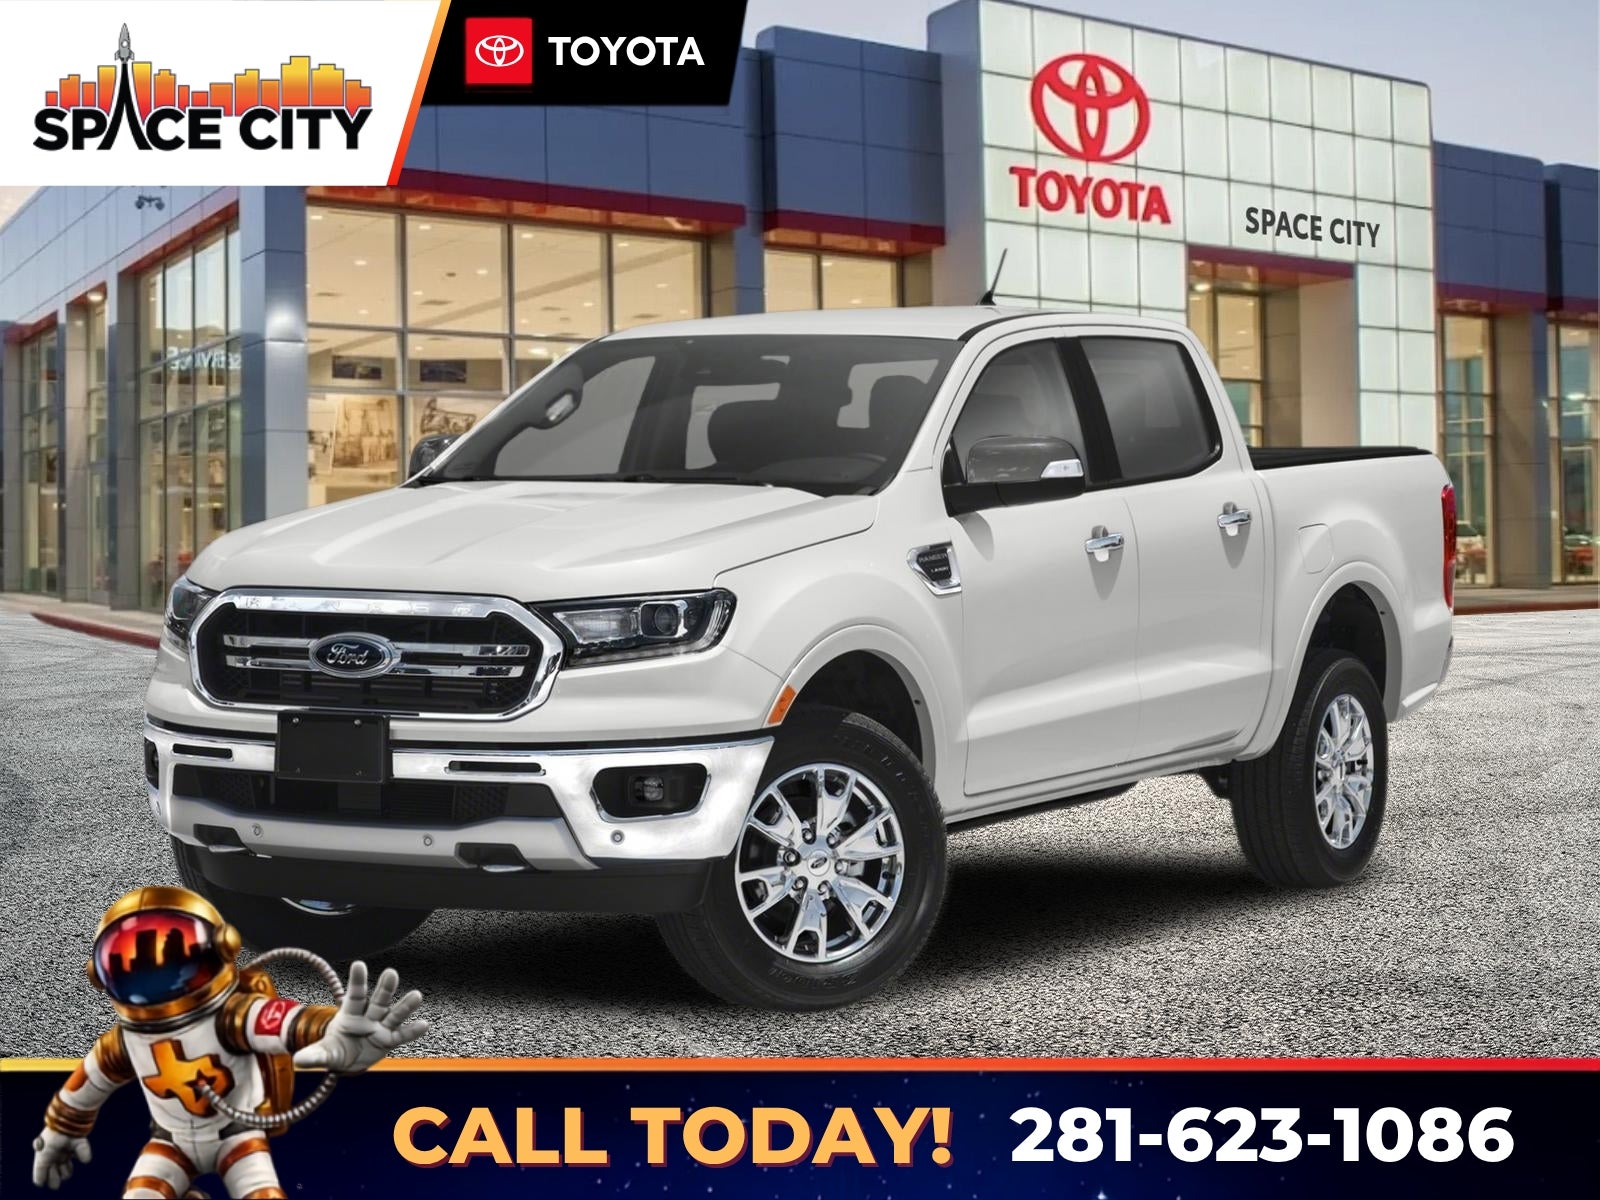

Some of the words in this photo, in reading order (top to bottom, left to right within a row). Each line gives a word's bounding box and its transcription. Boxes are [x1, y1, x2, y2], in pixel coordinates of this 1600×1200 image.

[1009, 165, 1171, 225] TOYOTA
[1245, 206, 1323, 242] SPACE
[1329, 217, 1381, 248] CITY
[326, 642, 369, 665] Ford
